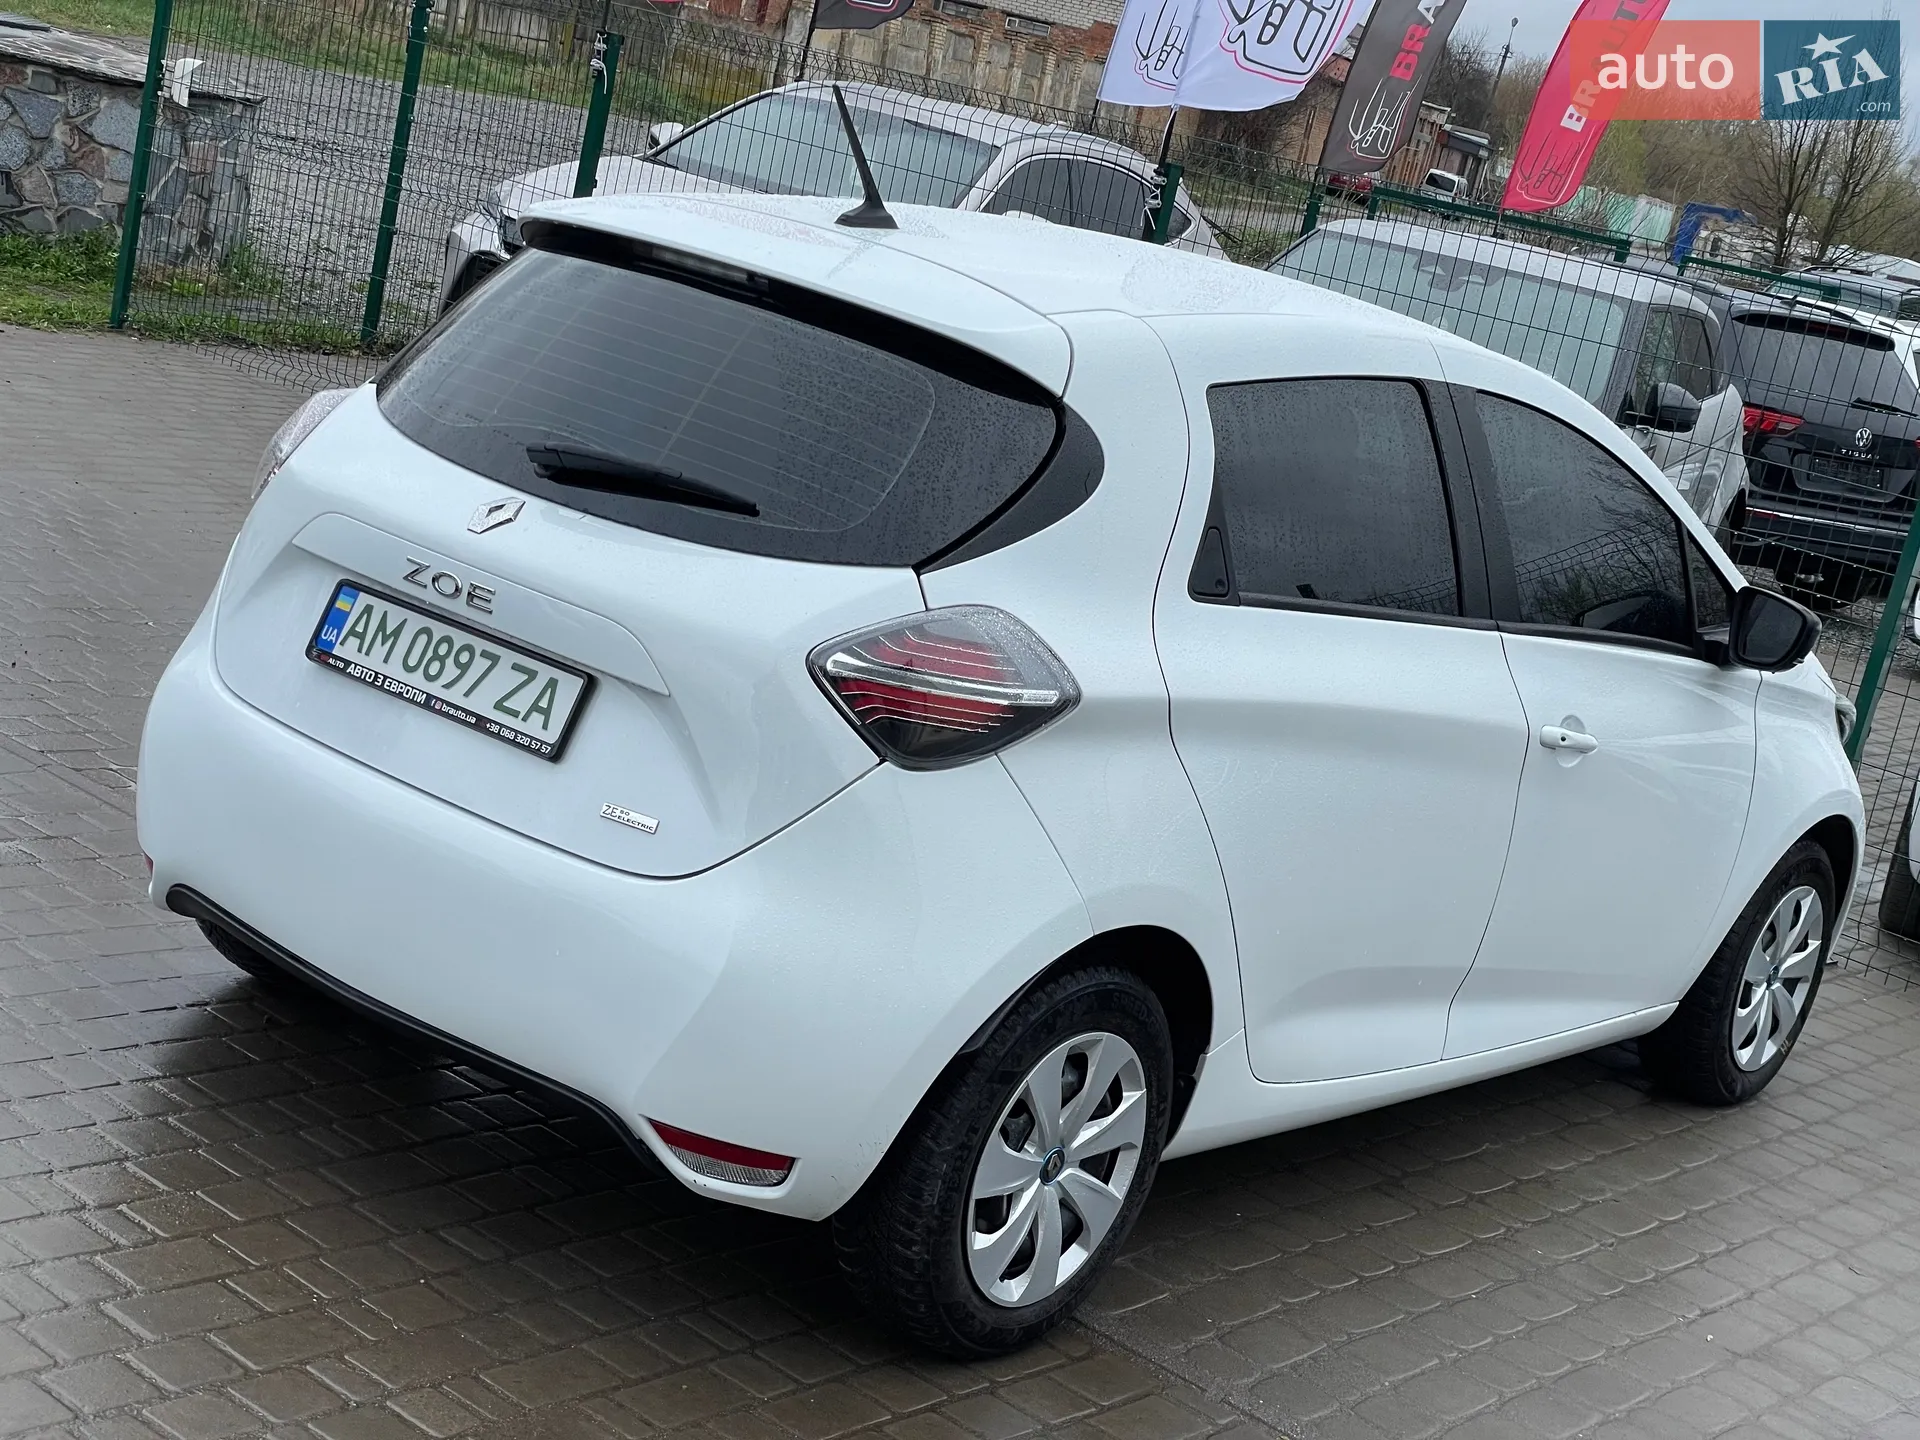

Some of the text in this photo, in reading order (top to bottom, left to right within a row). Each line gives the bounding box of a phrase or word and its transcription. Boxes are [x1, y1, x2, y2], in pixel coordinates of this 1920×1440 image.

[402, 555, 497, 615] ZOE
[320, 624, 339, 645] UA
[339, 603, 560, 732] AM 0897 ZA
[346, 663, 376, 683] АВТО
[441, 702, 477, 724] brauto.ua
[485, 722, 552, 755] +38 068 320 57 57
[617, 815, 654, 832] ELECTRIC
